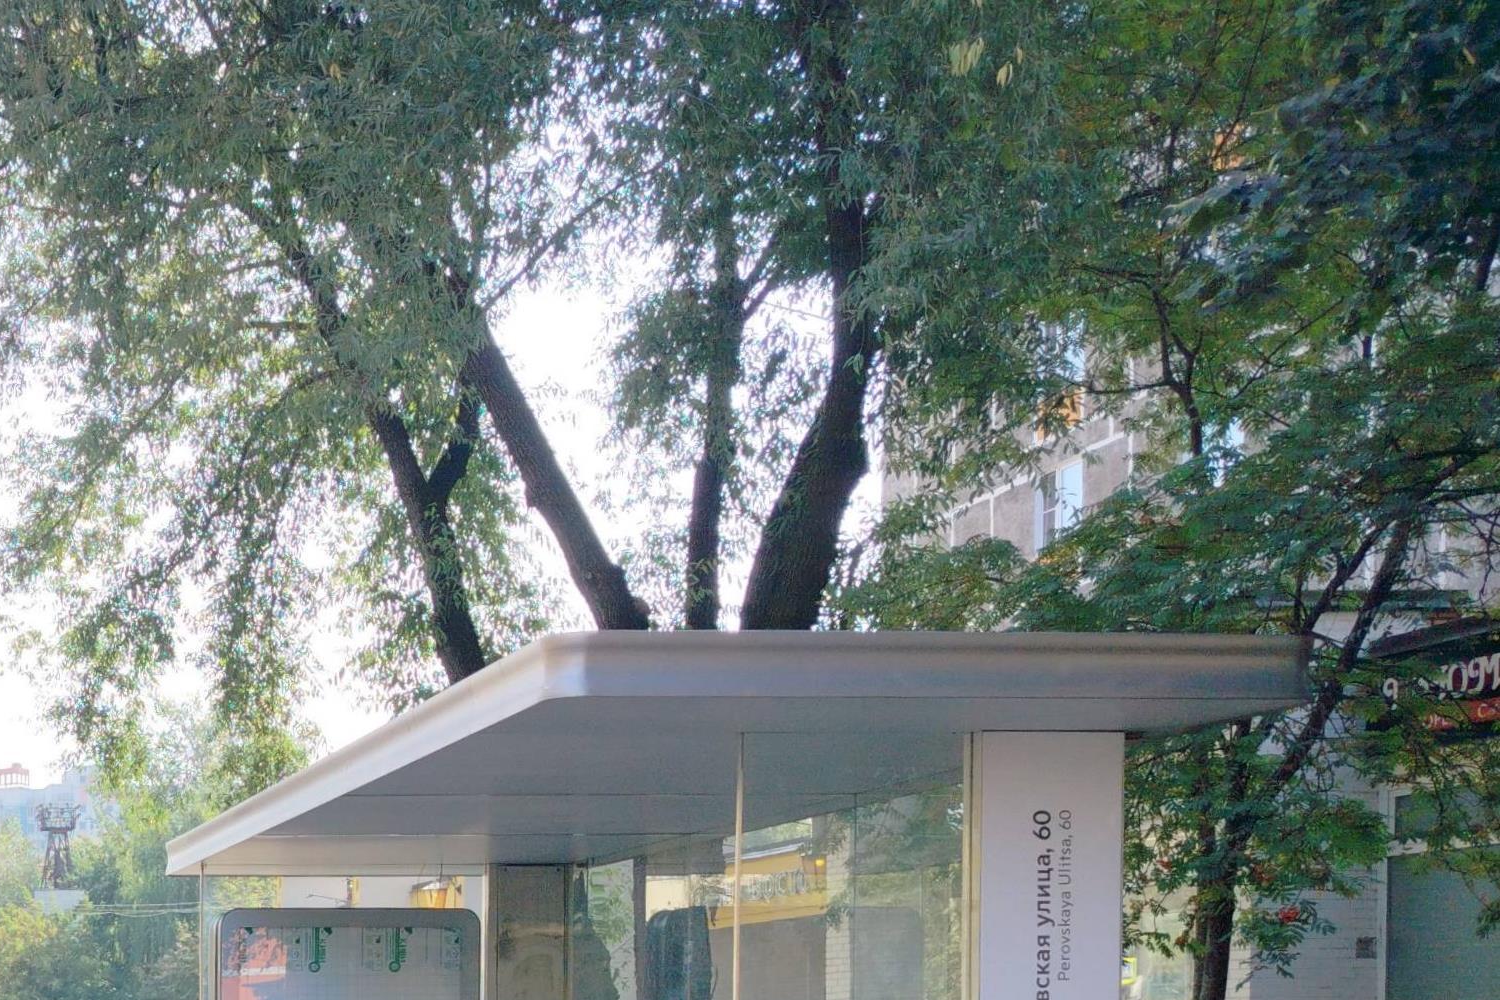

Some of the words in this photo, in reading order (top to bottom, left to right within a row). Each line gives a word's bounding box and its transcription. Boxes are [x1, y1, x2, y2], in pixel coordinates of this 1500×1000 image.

[1032, 810, 1051, 840] 60
[1058, 809, 1071, 830] 60
[1058, 835, 1073, 885] Ulitsa,
[1036, 848, 1055, 928] улица,
[1058, 891, 1073, 981] Perovskaya
